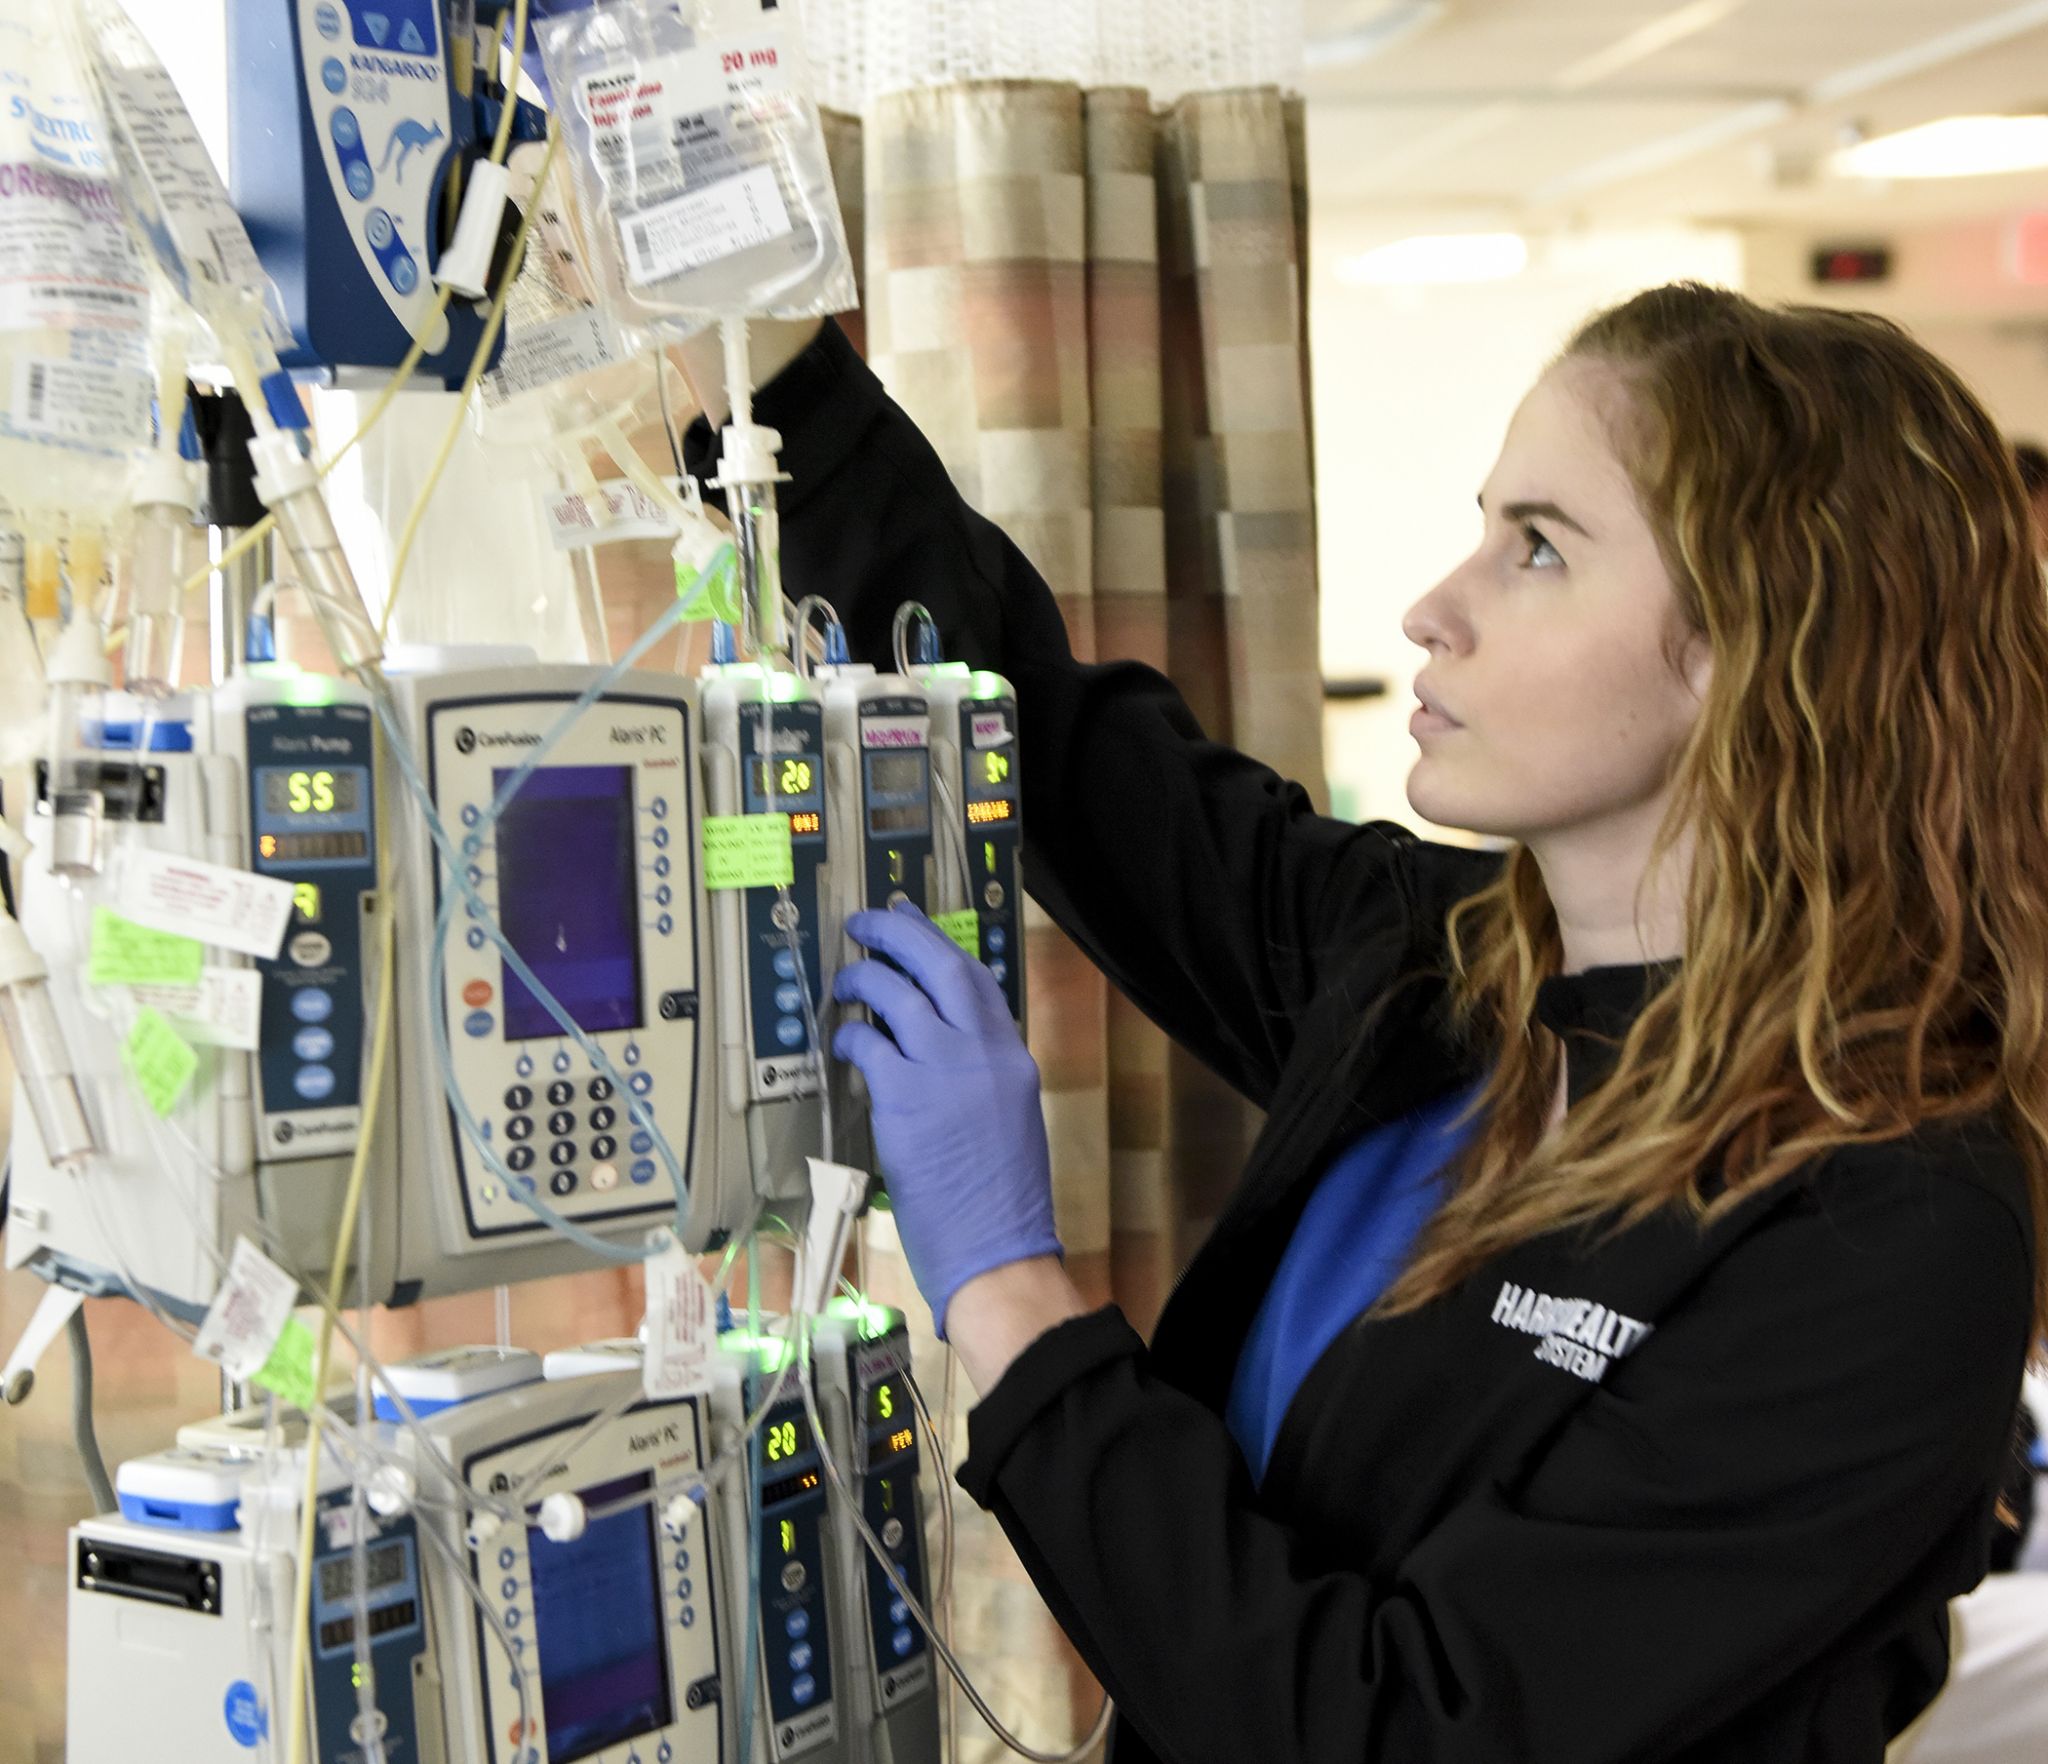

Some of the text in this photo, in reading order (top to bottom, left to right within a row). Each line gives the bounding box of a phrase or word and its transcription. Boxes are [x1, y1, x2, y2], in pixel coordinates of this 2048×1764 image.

[349, 53, 438, 82] KANGAROO
[722, 47, 778, 74] 20 mg
[768, 1421, 796, 1461] 20
